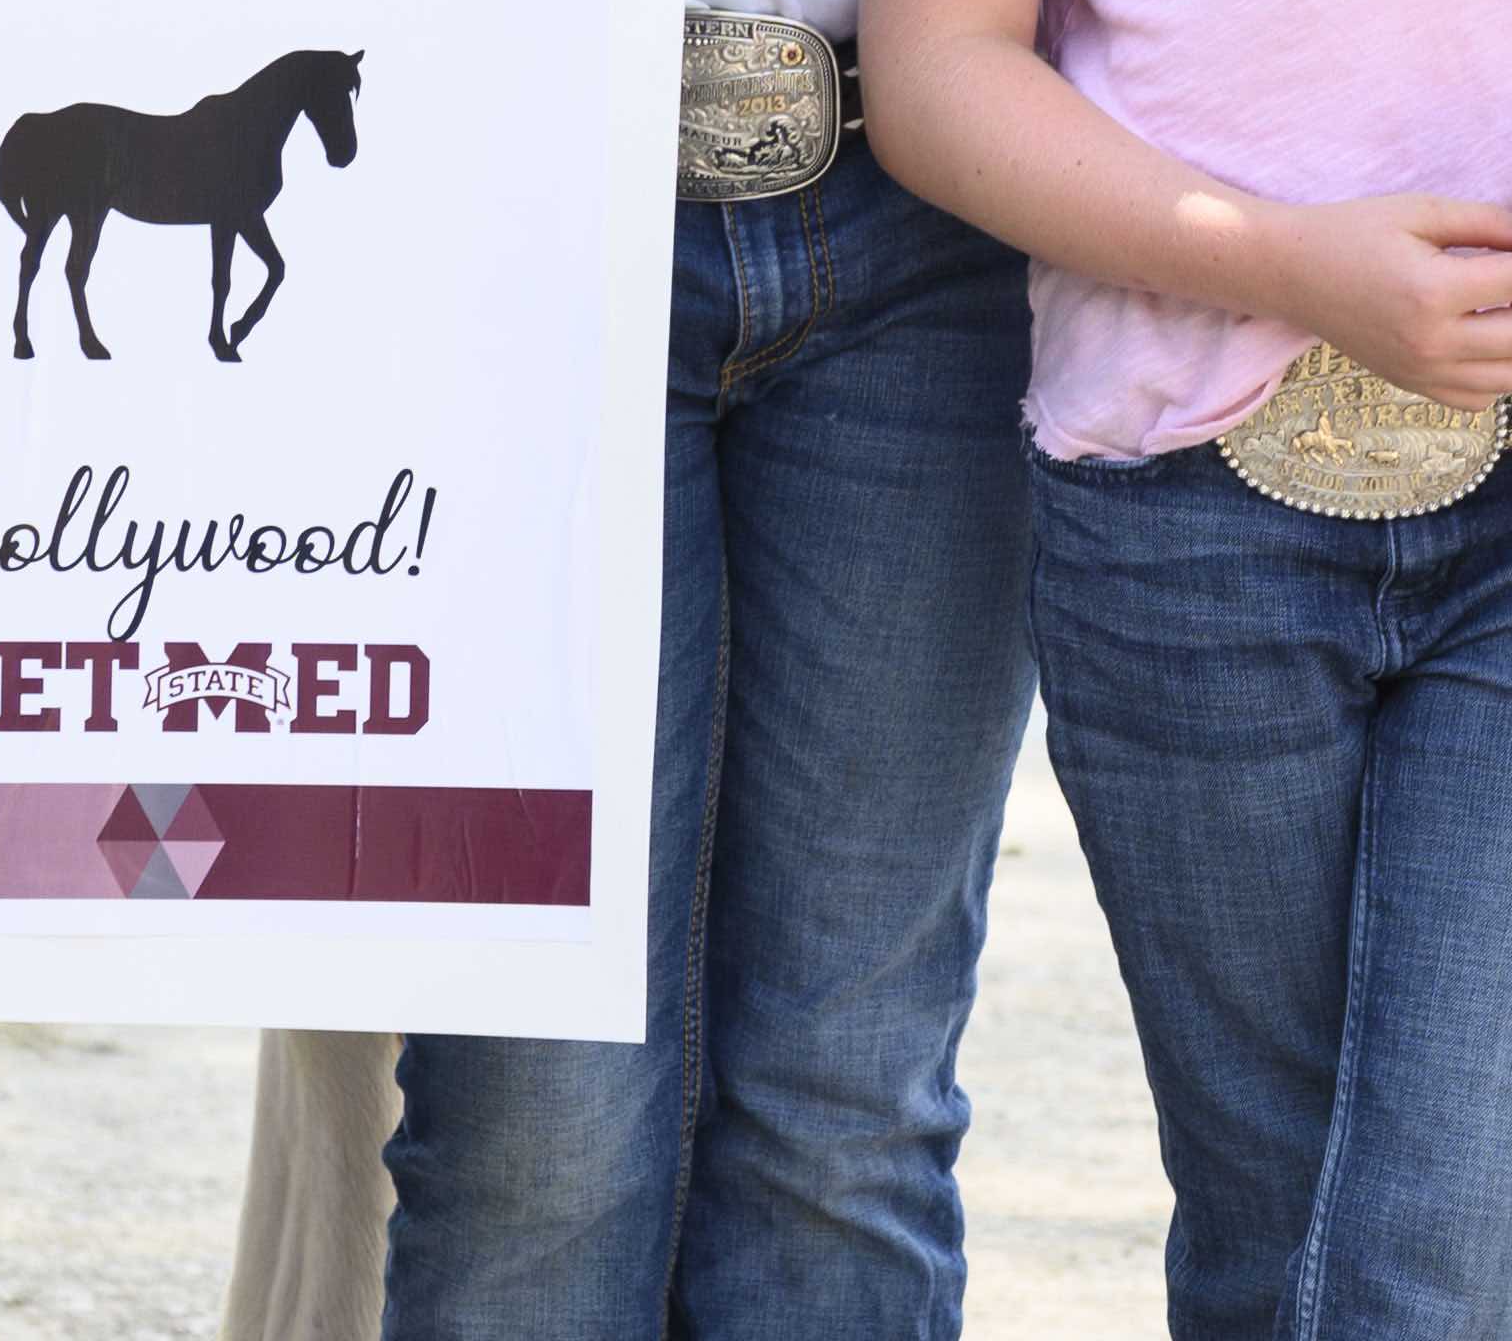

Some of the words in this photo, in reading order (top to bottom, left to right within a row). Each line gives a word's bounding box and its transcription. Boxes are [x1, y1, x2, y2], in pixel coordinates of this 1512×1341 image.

[738, 93, 787, 116] 2013
[162, 642, 431, 735] MED
[168, 669, 265, 699] STATE
